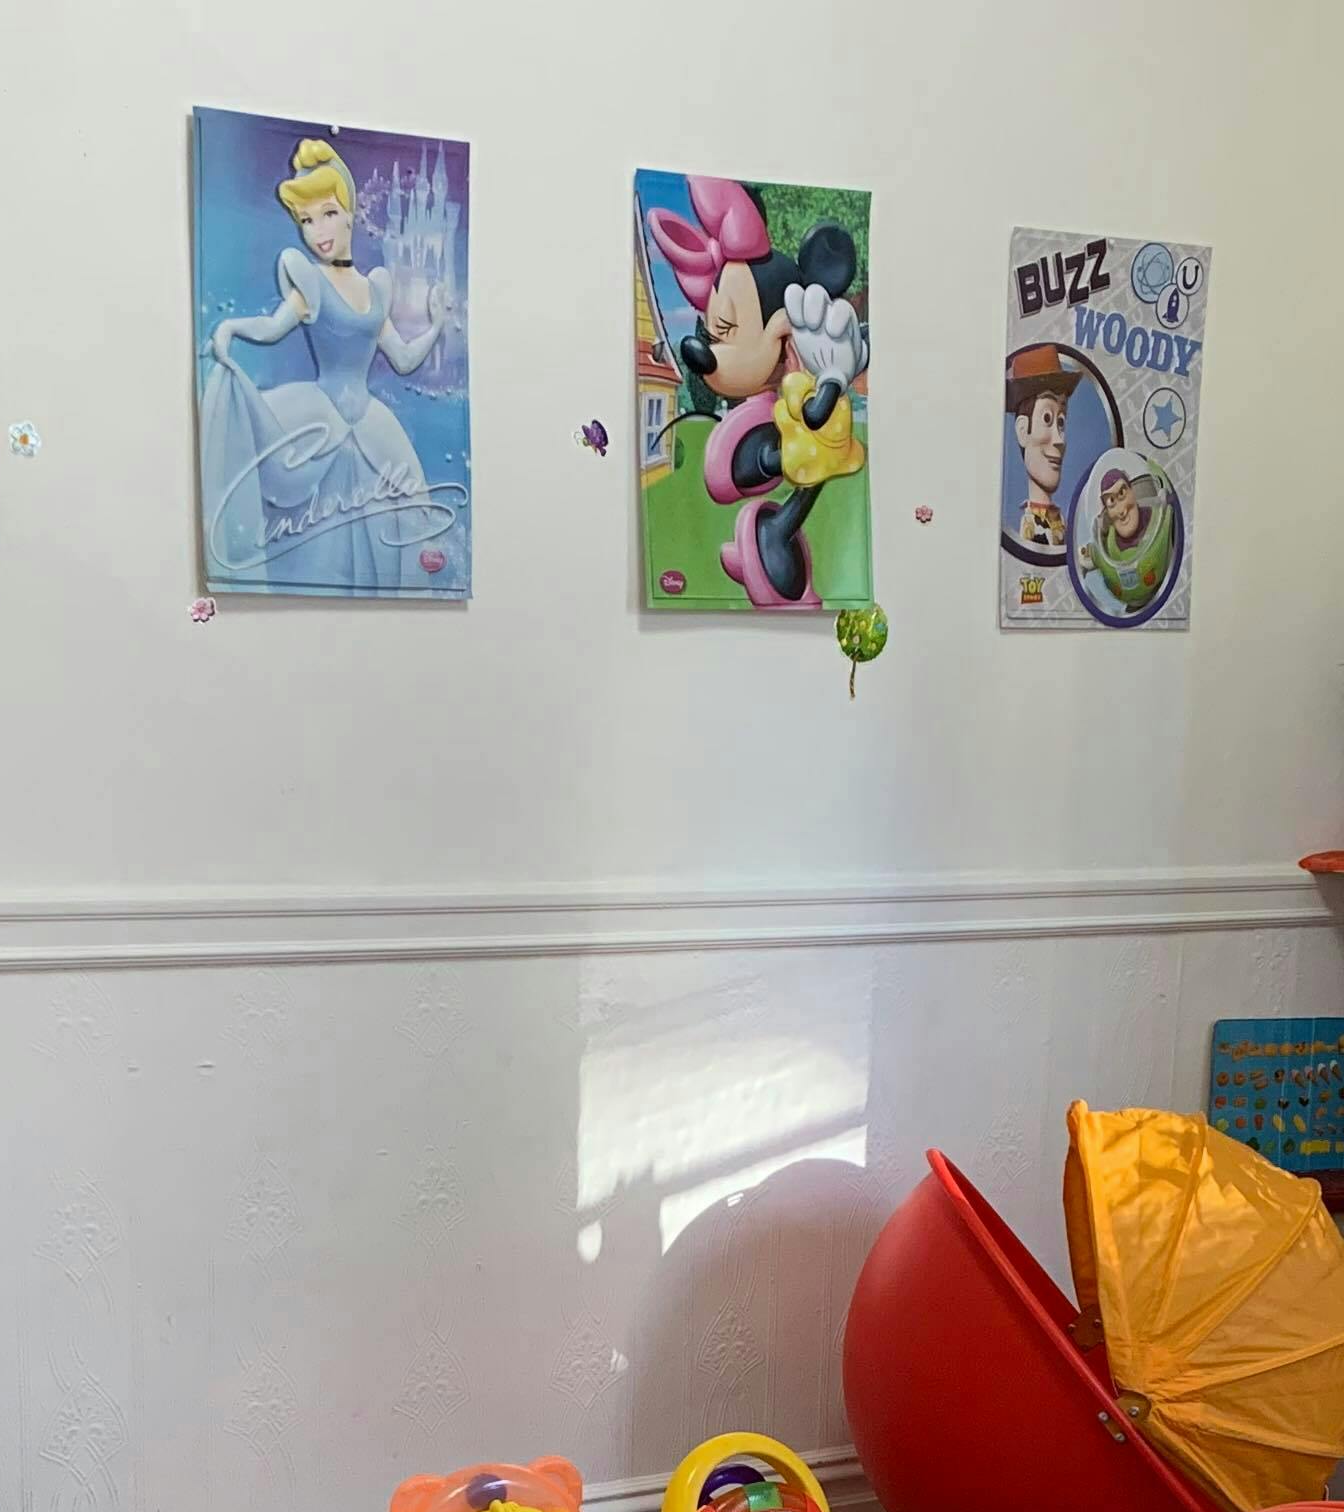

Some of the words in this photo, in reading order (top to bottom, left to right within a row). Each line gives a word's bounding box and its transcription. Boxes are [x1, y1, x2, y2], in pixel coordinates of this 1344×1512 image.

[1015, 238, 1111, 317] BUZZ
[1072, 303, 1203, 378] WOODY
[210, 423, 468, 570] Cinderella
